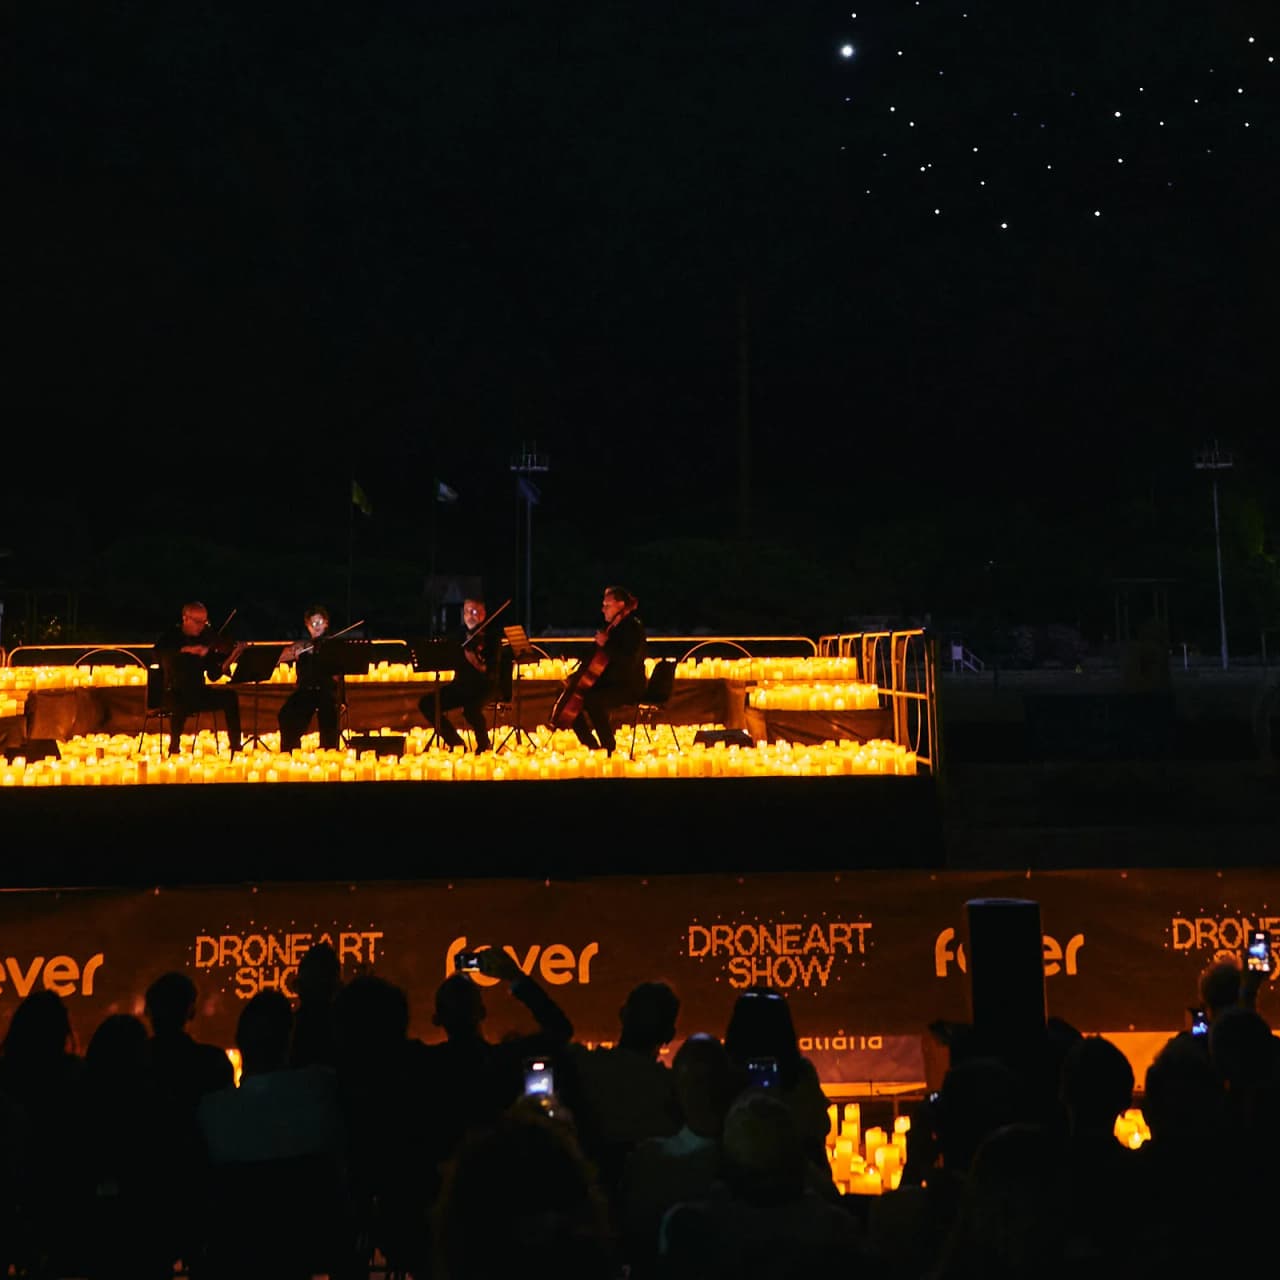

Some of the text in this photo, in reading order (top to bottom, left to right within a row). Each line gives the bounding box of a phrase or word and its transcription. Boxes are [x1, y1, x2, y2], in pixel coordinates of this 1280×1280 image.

[195, 931, 384, 968] DRONERT
[688, 922, 872, 957] DRONEART
[935, 927, 1085, 978] fer
[234, 966, 300, 1000] SHO
[728, 955, 834, 989] SHOW
